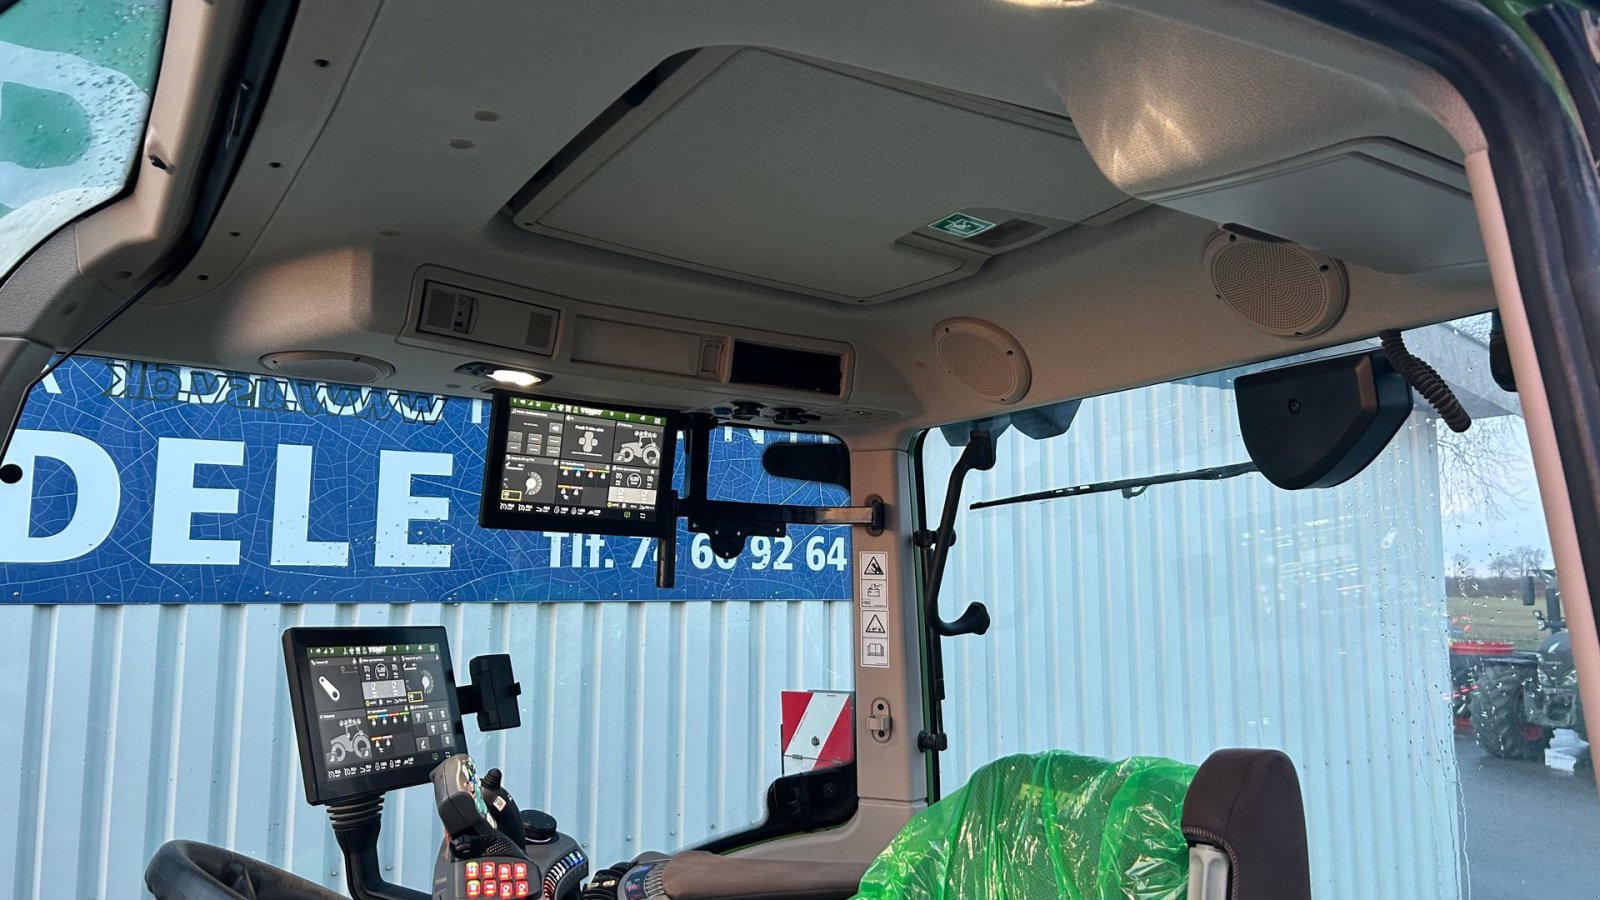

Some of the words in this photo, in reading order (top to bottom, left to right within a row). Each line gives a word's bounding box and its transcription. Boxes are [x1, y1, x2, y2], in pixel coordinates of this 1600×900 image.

[543, 531, 615, 568] Tlf.
[628, 535, 678, 569] 7
[749, 532, 794, 570] 92
[805, 536, 848, 572] 64
